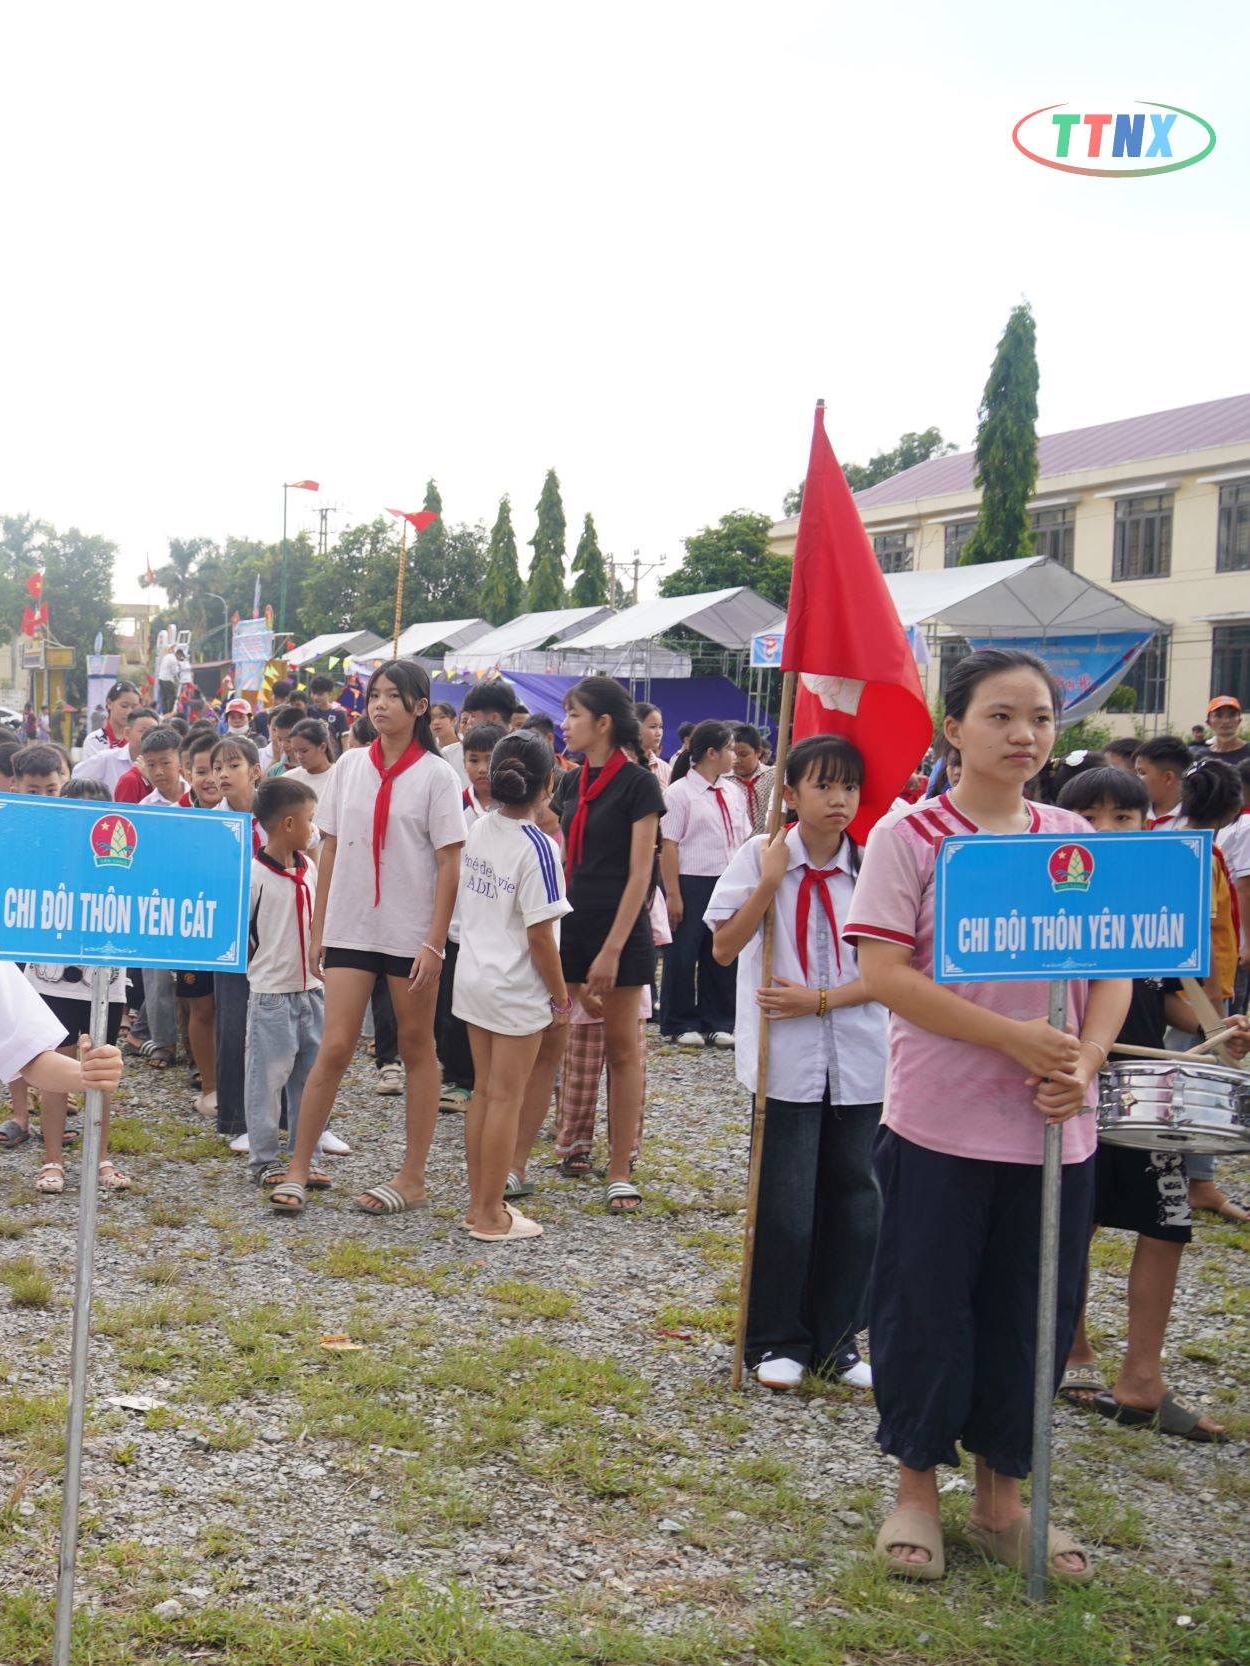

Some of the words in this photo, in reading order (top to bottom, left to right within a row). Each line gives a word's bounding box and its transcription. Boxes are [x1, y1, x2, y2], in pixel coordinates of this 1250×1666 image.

[4, 887, 36, 928] CHI
[40, 882, 75, 940] ĐỘI
[80, 886, 132, 934] THÔN
[137, 888, 175, 936] YÊN
[179, 891, 217, 939] CÁT
[958, 917, 990, 953] CHI
[994, 909, 1026, 959] ĐỘI
[1031, 908, 1082, 951] THÔN
[1088, 907, 1126, 950] YÊN
[1130, 906, 1184, 949] XUÂN
